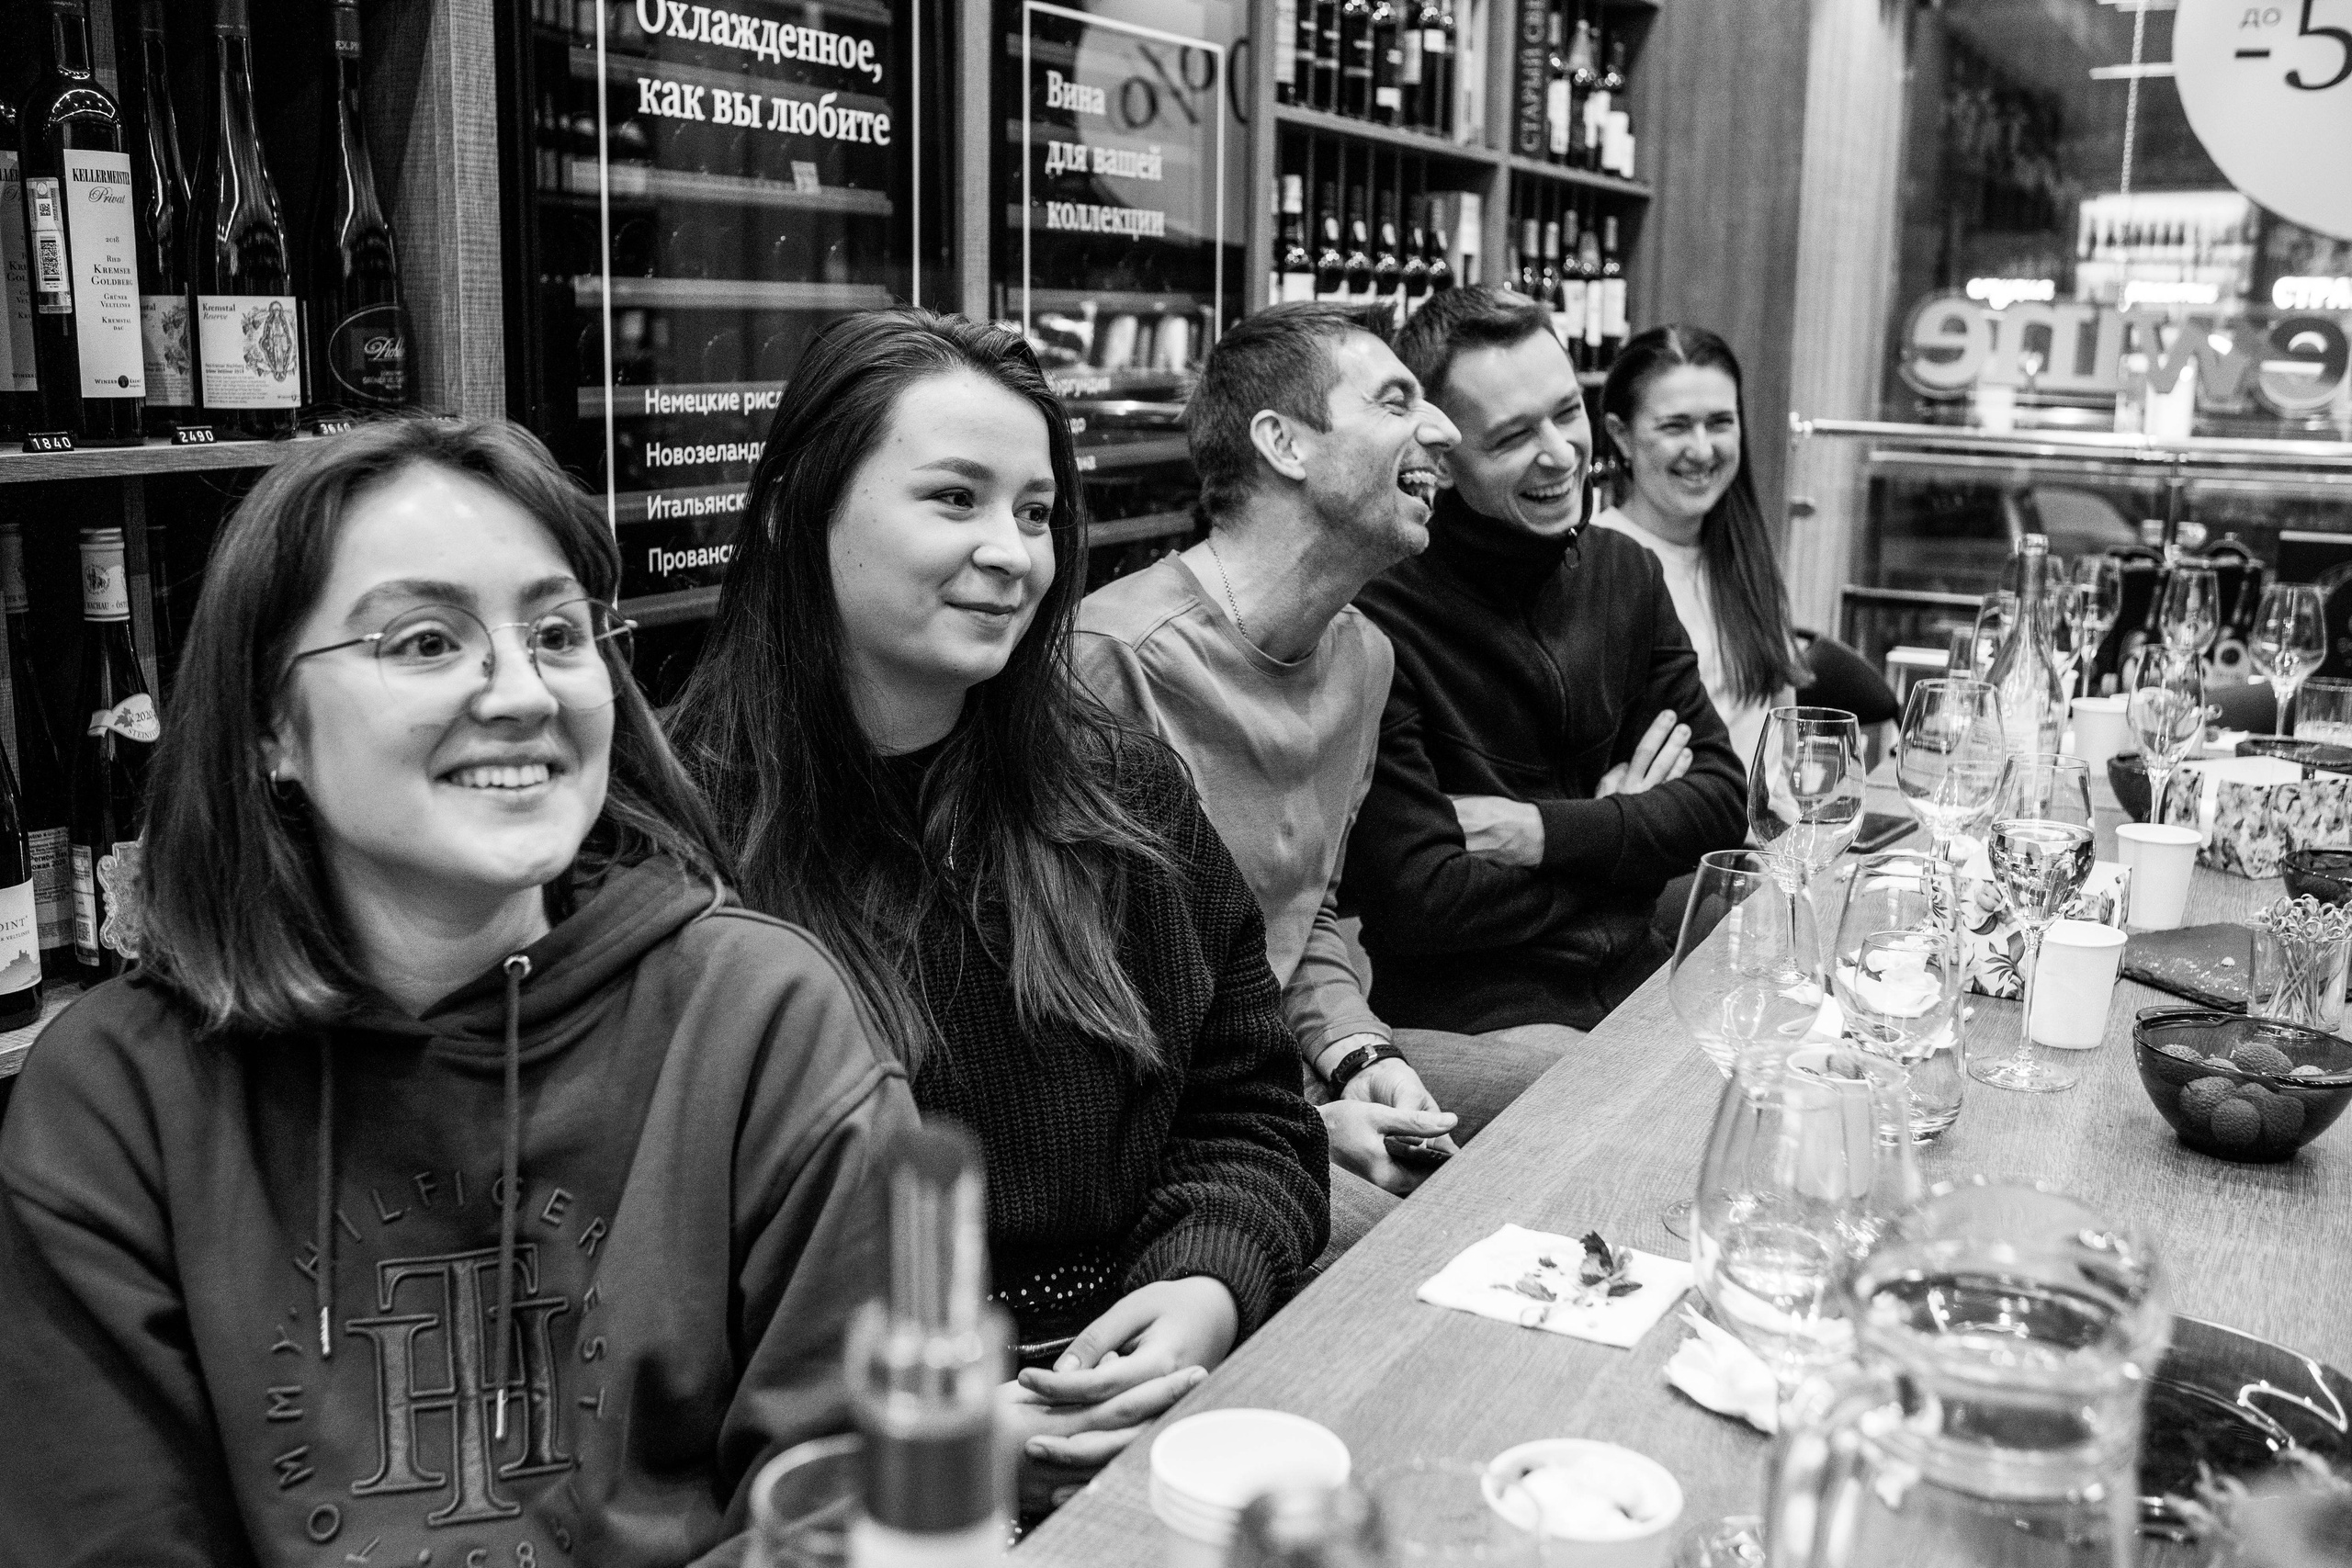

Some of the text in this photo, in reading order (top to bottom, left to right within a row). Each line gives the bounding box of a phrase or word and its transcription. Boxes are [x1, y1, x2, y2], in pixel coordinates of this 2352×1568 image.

[2238, 7, 2281, 28] до
[636, 0, 883, 84] Охлажденное,
[1046, 70, 1106, 116] Вина
[637, 77, 891, 146] как вы любите
[1045, 140, 1162, 181] для вашей
[1046, 200, 1165, 242] коллекции
[202, 302, 236, 312] Kremstal
[645, 389, 741, 416] Немецкие
[32, 435, 72, 450] 1840
[179, 429, 214, 444] 2490
